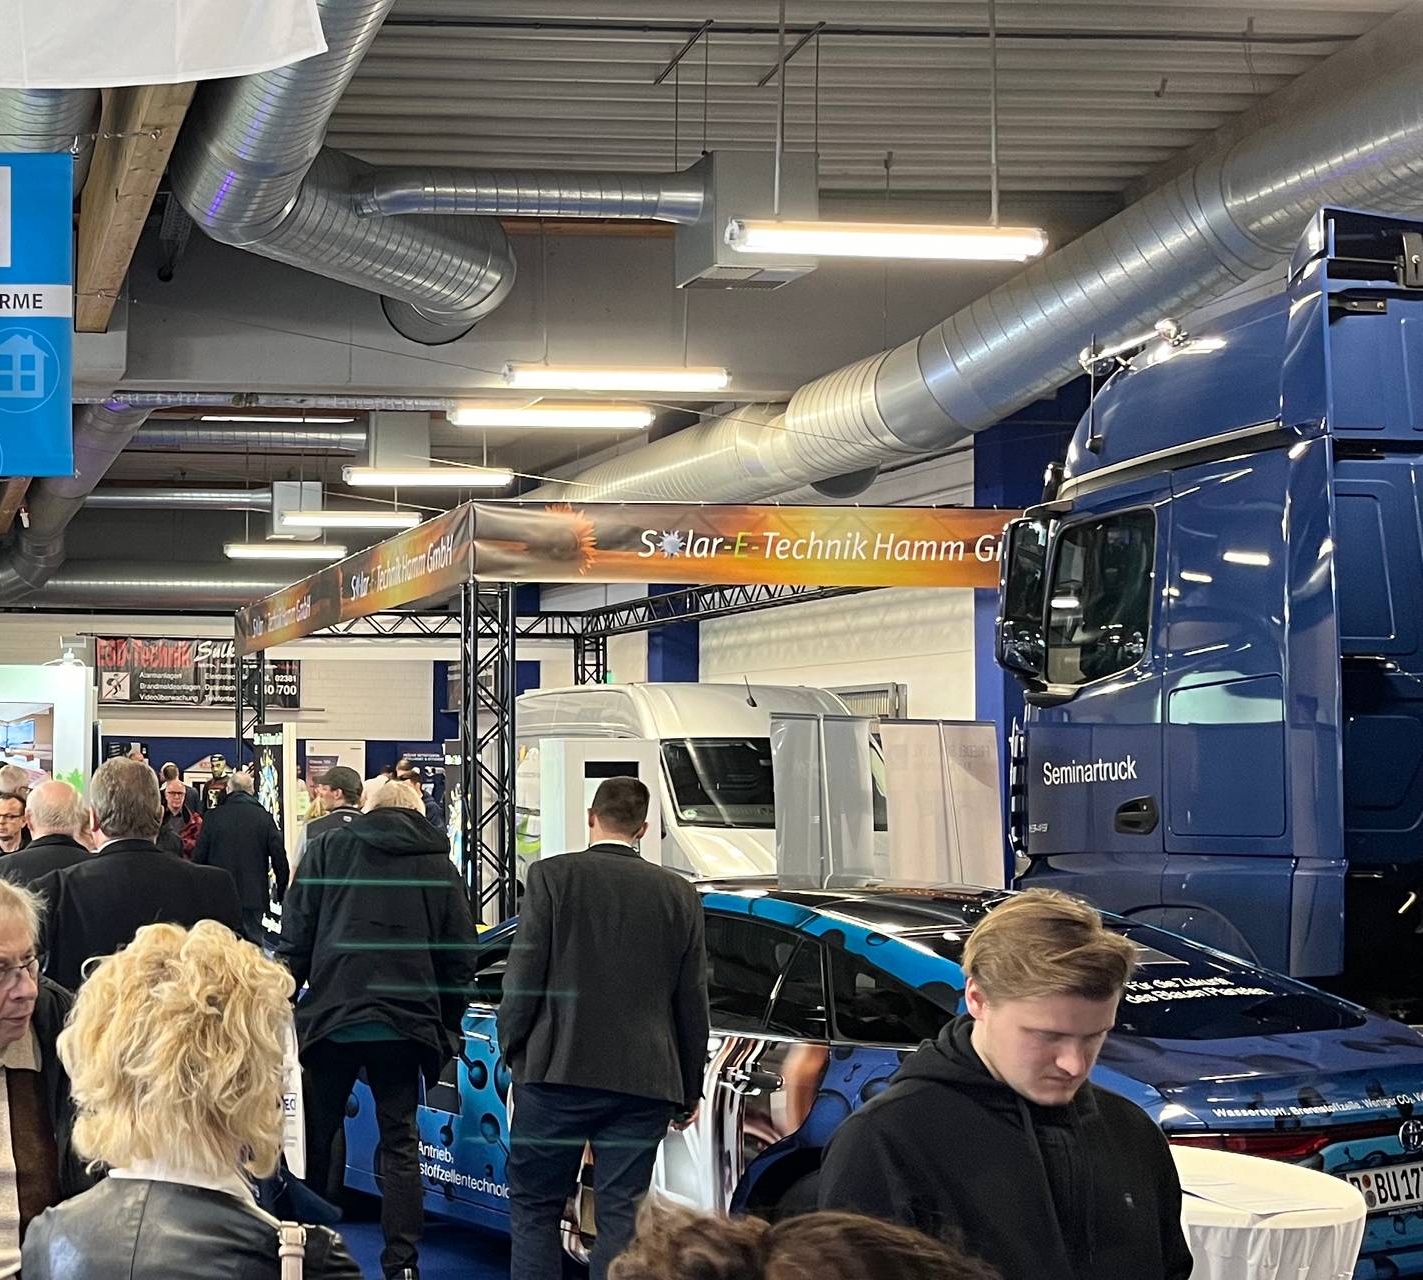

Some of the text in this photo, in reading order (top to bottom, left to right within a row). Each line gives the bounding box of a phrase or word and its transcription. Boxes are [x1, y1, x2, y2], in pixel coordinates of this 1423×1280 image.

[426, 534, 454, 573] GmbH
[873, 532, 964, 562] Hamm
[194, 640, 235, 662] Sulk
[277, 684, 297, 695] 700
[1043, 754, 1138, 786] Seminartruck
[1361, 1097, 1397, 1109] Weniger
[1374, 1171, 1401, 1204] BU
